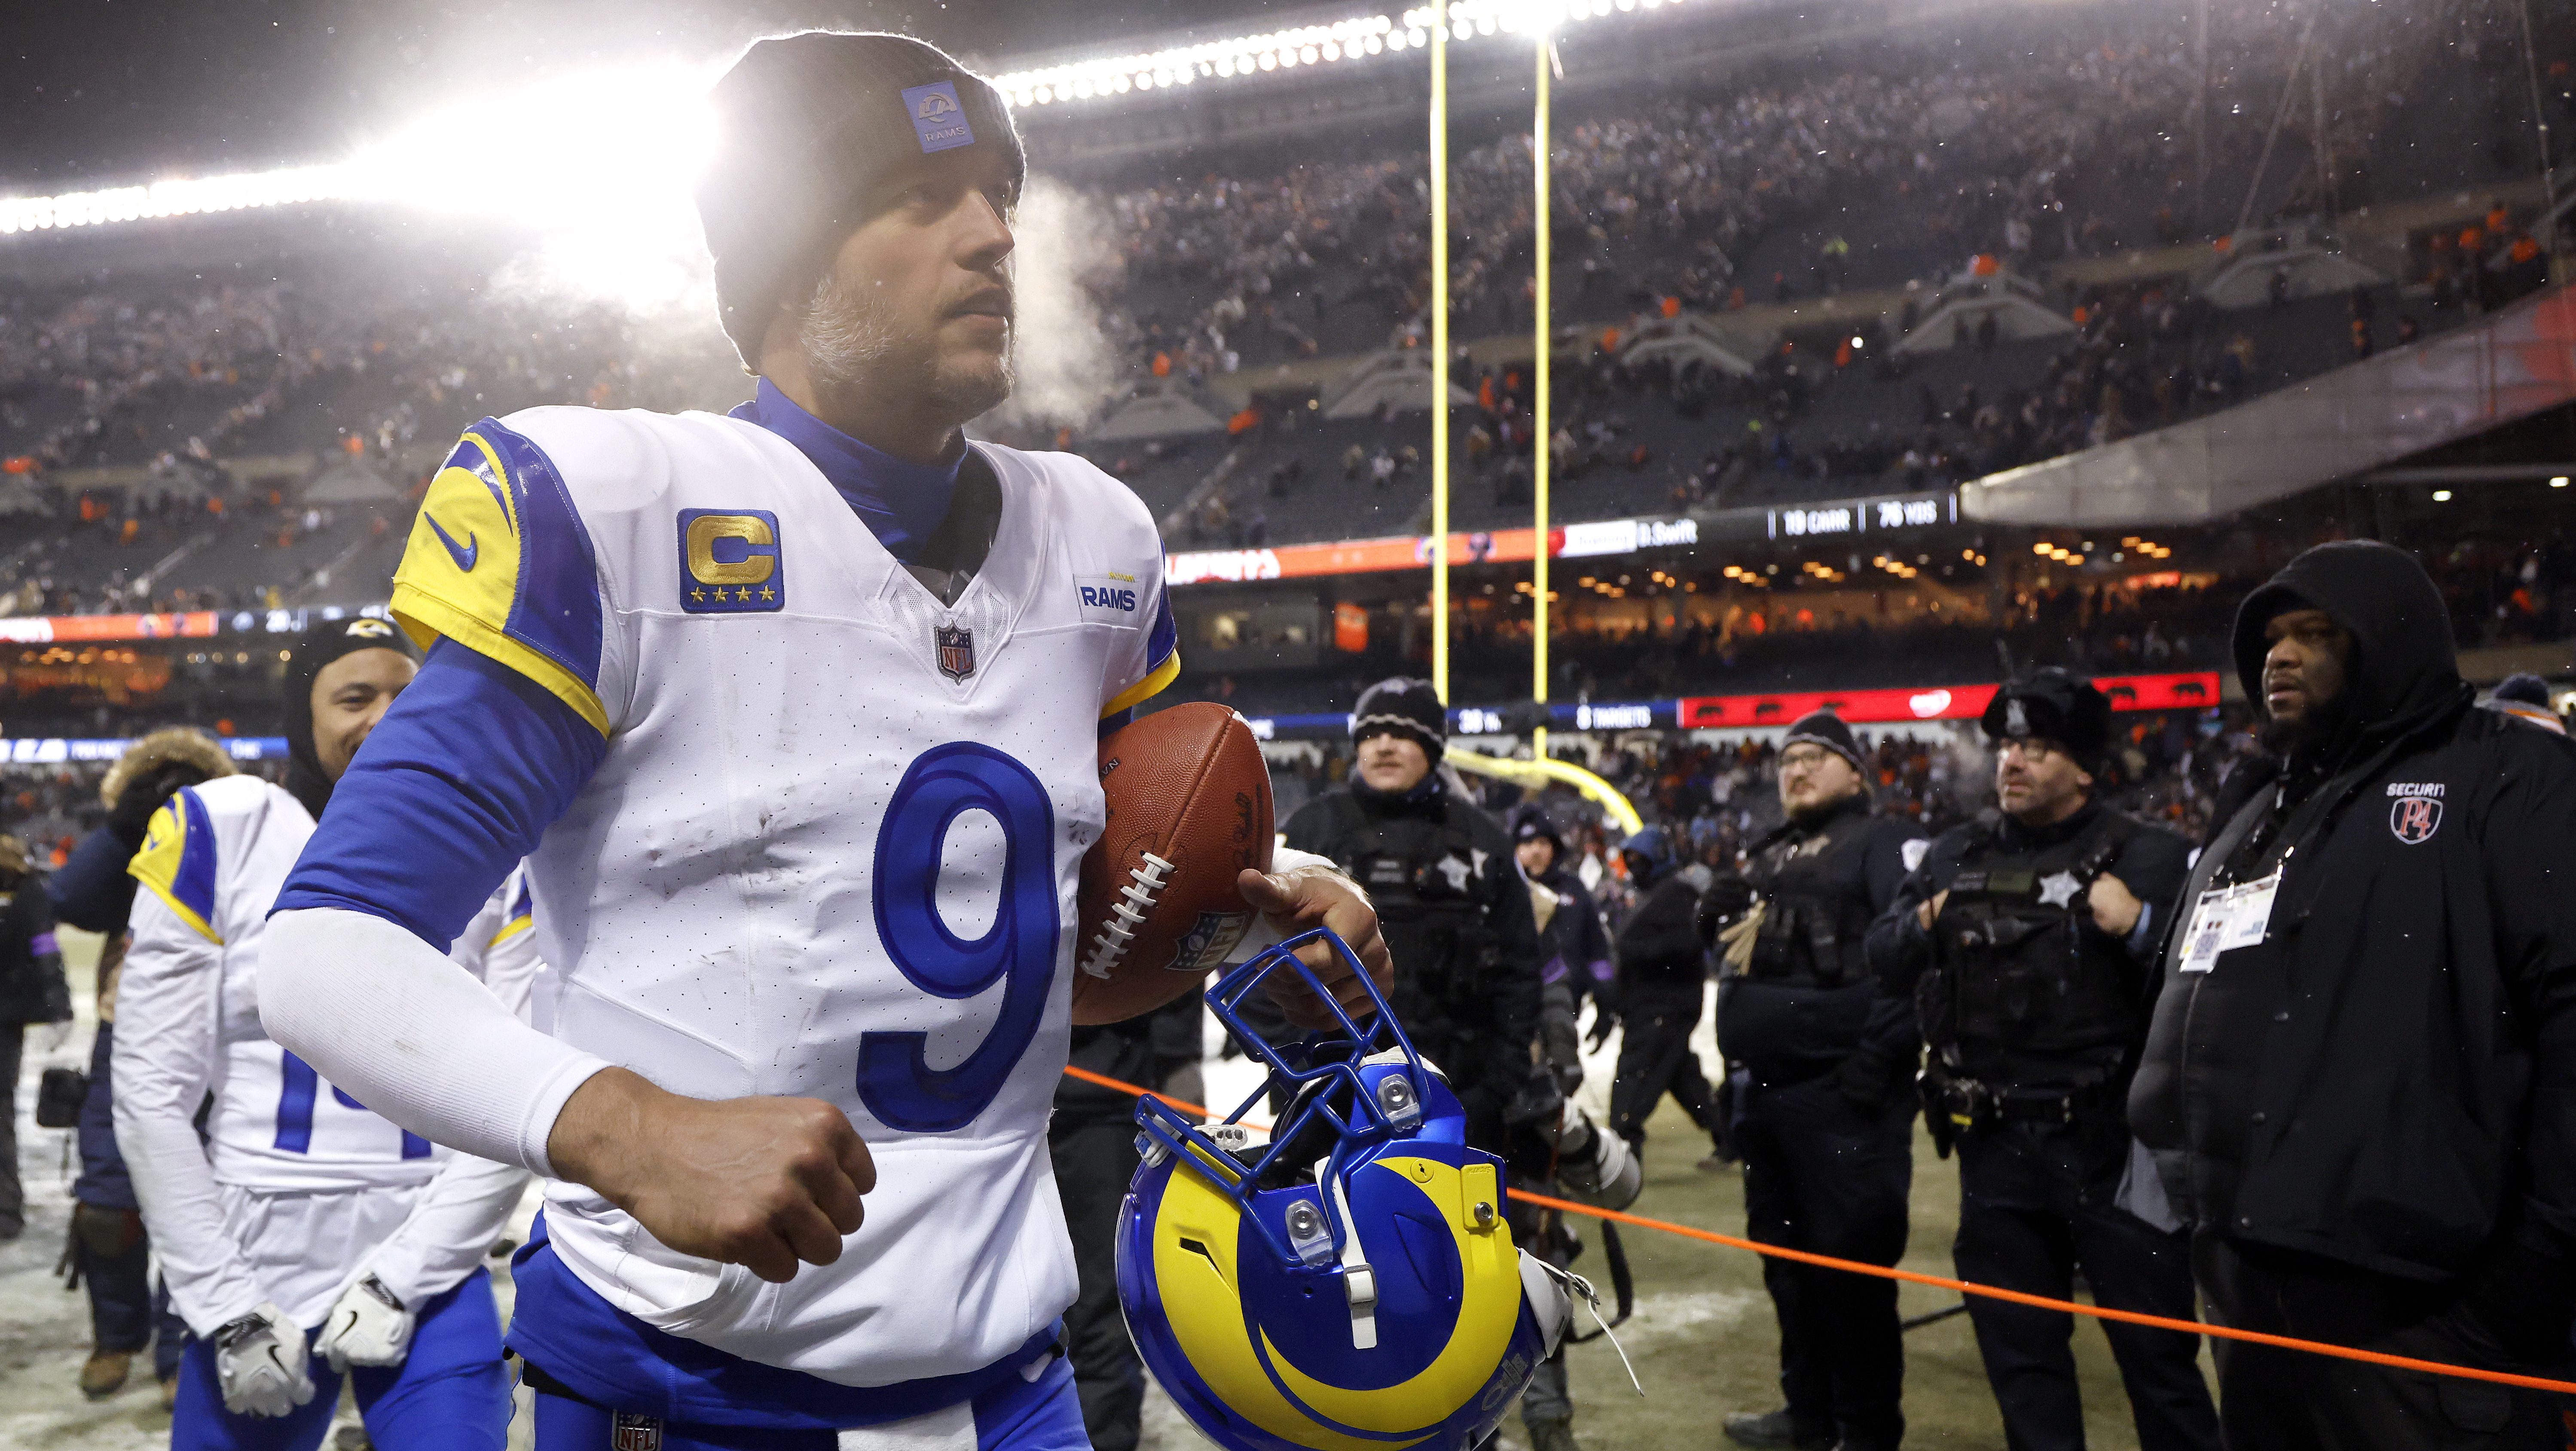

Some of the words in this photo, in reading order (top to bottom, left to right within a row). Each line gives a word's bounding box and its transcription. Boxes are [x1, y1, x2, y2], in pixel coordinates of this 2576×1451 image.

[925, 127, 965, 141] RAMS
[687, 515, 775, 585] C
[1080, 587, 1136, 611] RAMS
[943, 647, 971, 672] NFL
[856, 741, 1060, 1133] 9
[620, 1428, 654, 1451] NFL
